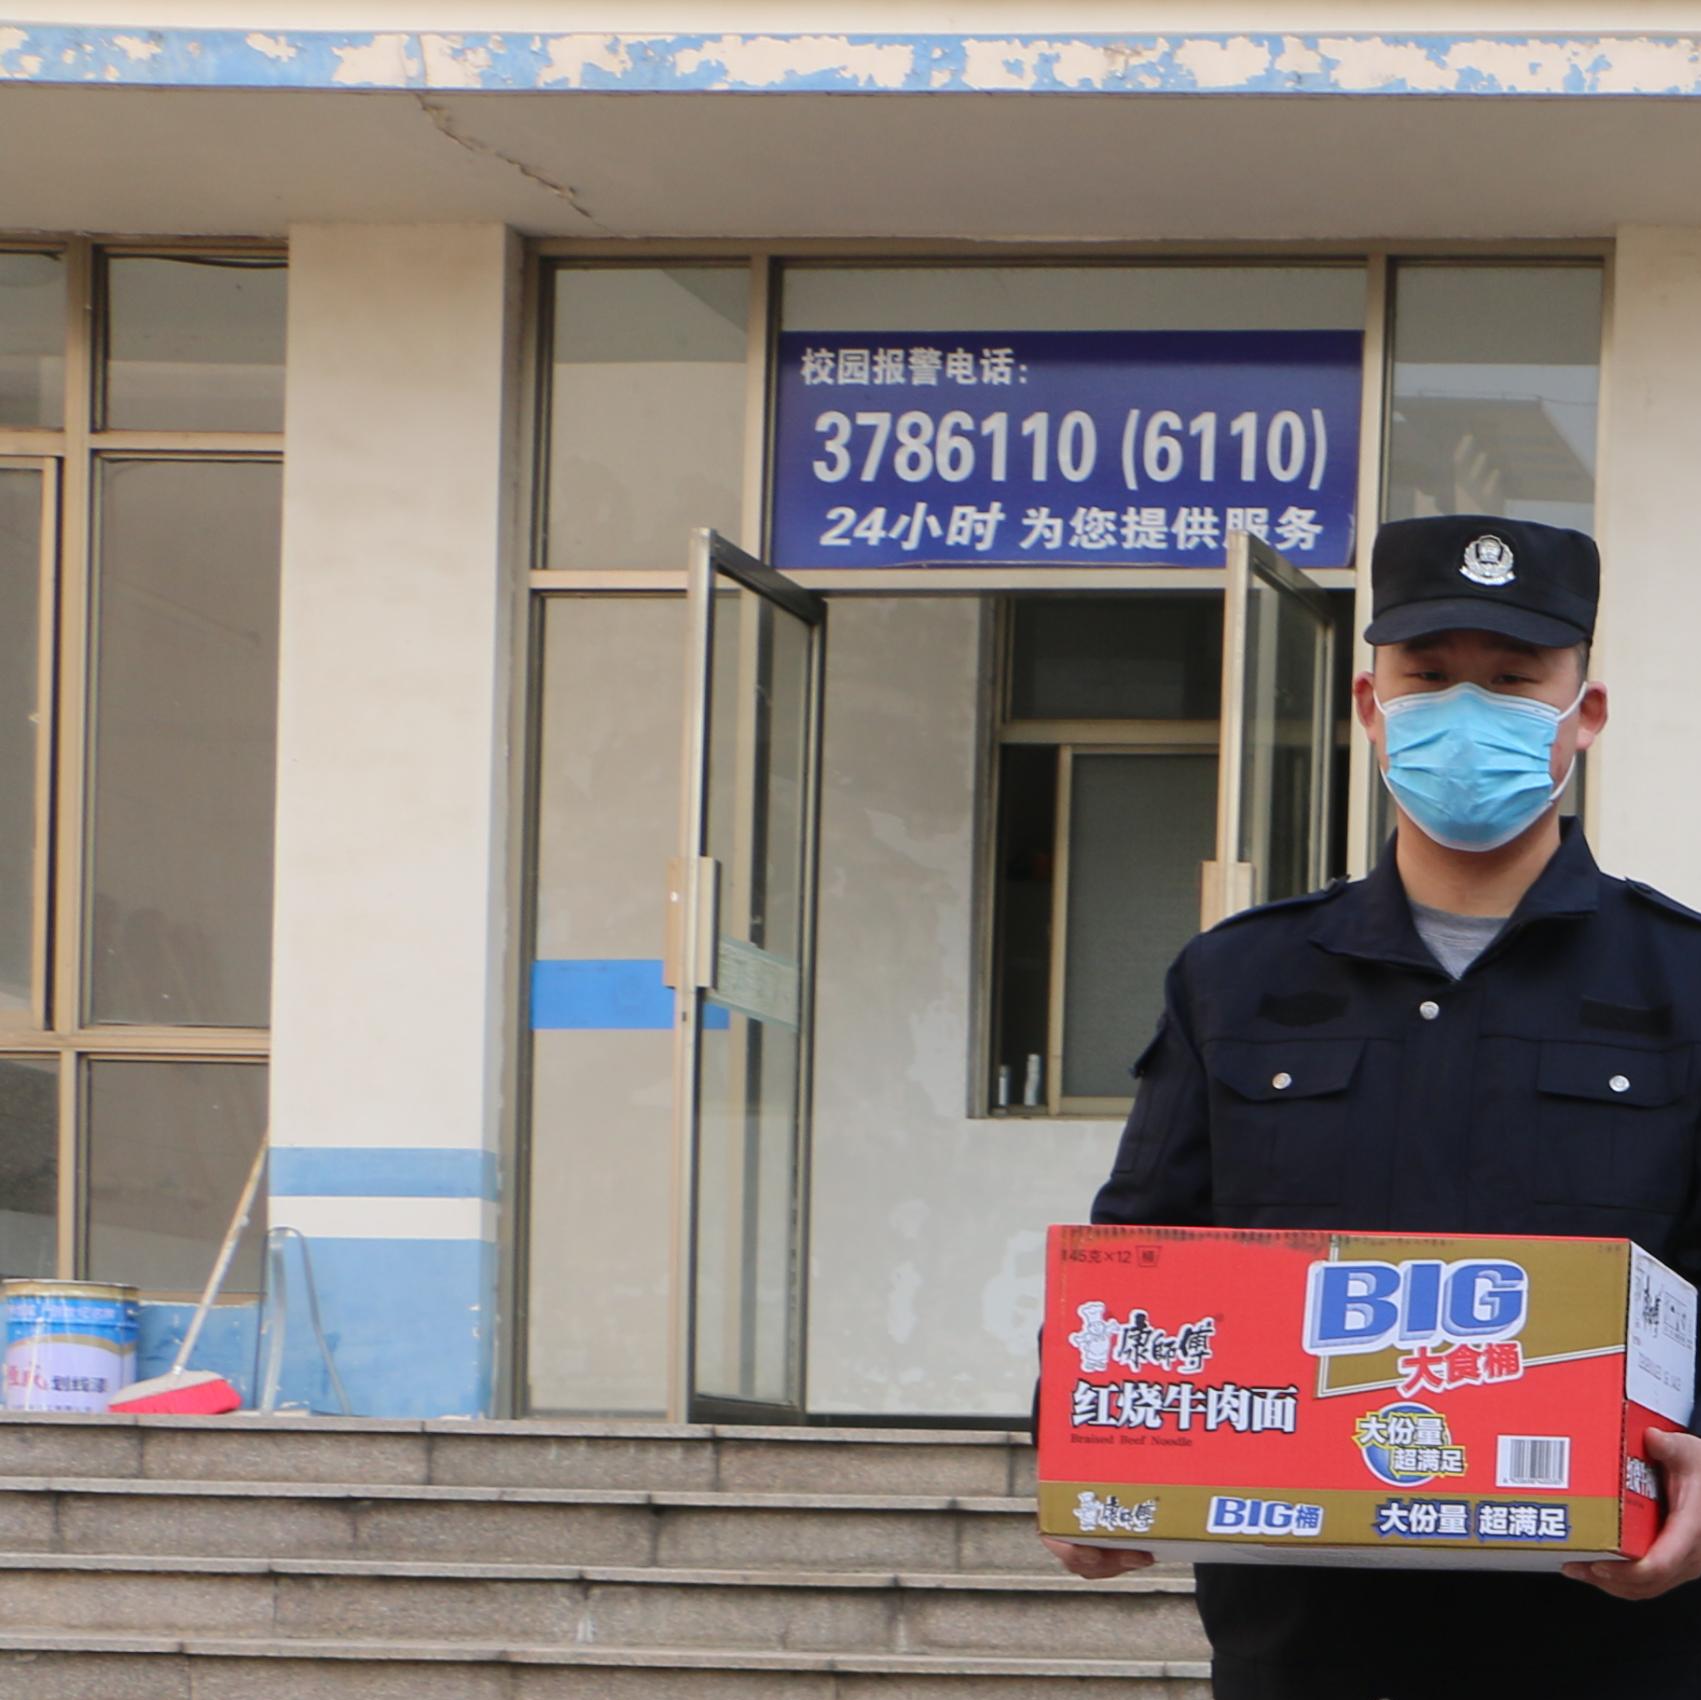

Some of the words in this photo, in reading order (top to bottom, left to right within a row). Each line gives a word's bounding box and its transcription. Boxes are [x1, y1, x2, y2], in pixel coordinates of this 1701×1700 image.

[813, 409, 1097, 485] 3786110
[1121, 406, 1328, 491] (6110)
[819, 502, 1005, 551] 24小时
[1020, 505, 1324, 552] 为您提供服务
[1307, 1261, 1526, 1352] BIG
[1398, 1343, 1522, 1396] 大食桶
[1071, 1380, 1298, 1433] 红烧牛肉面
[1358, 1415, 1445, 1446] 大份量
[1120, 1434, 1145, 1446] Beef
[1150, 1435, 1193, 1447] Noodle
[1393, 1447, 1464, 1473] 超满足
[1378, 1502, 1468, 1535] 大份量
[1478, 1505, 1568, 1537] 超满足
